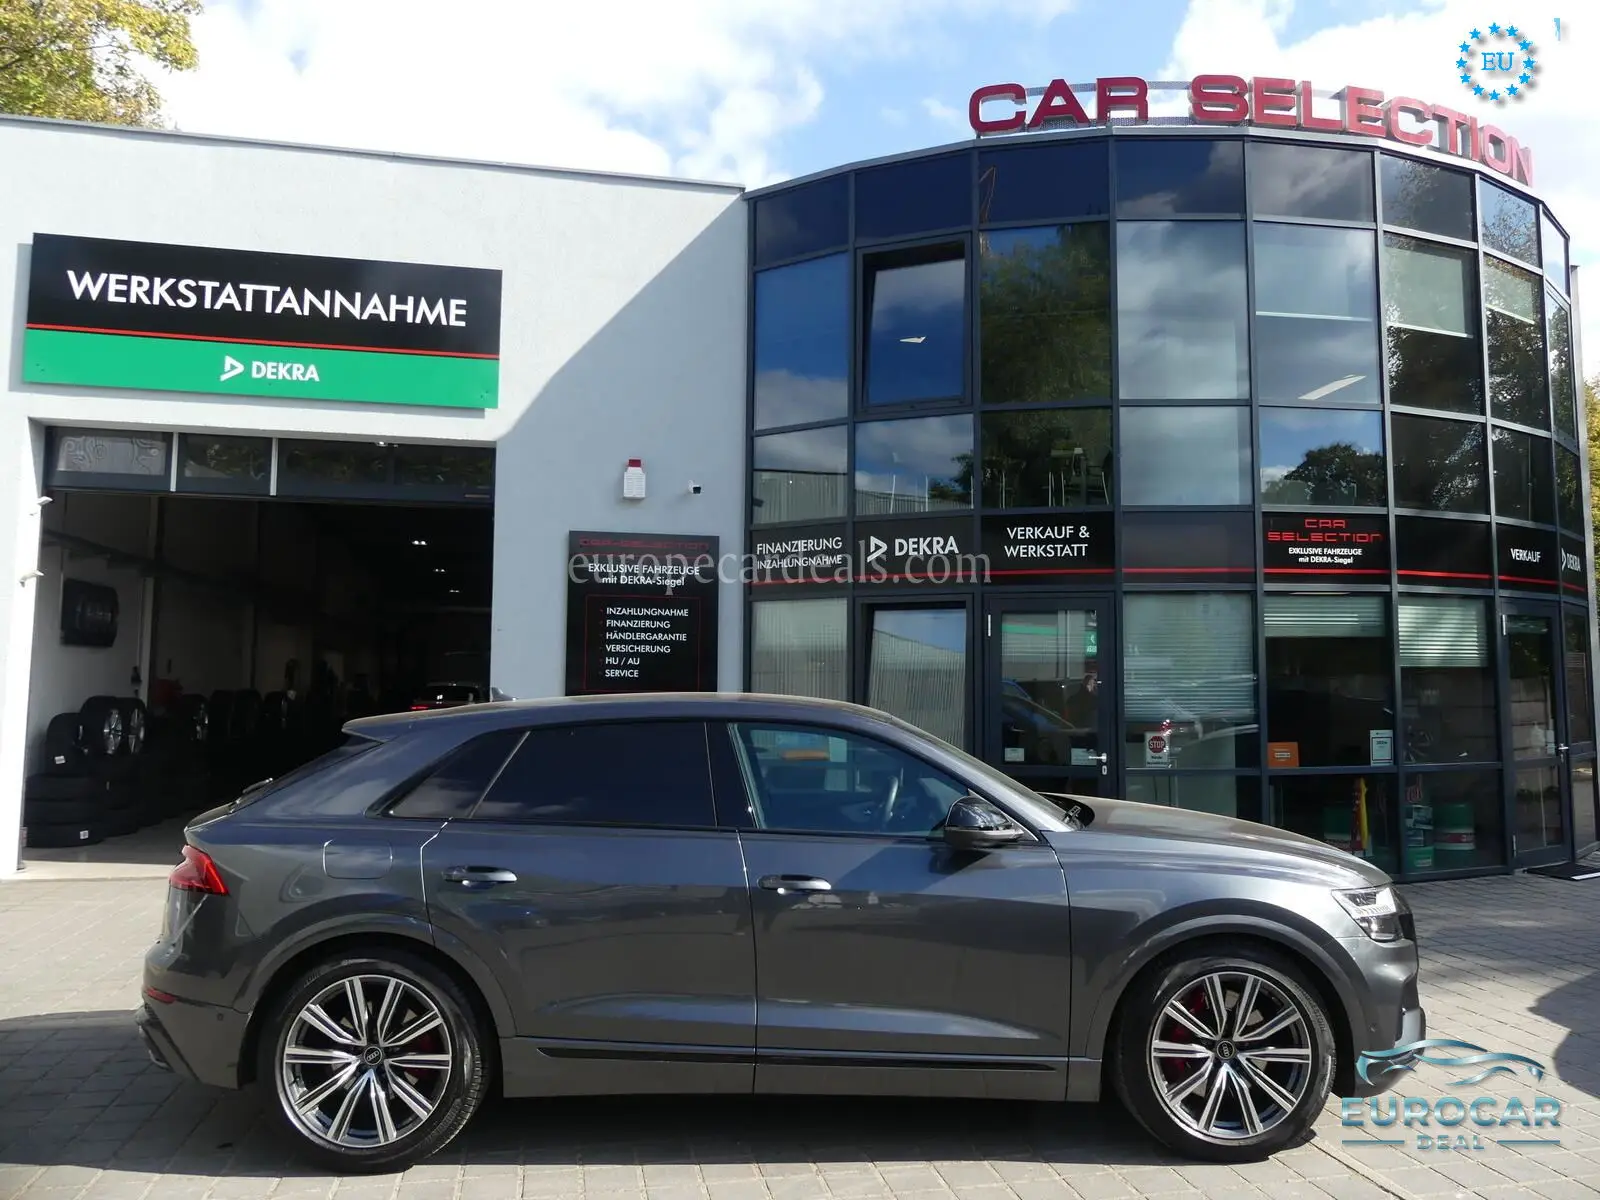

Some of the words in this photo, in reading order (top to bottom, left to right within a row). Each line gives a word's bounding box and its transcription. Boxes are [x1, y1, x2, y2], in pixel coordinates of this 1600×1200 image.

[969, 77, 1148, 132] CAR
[1190, 74, 1534, 187] SELECTION
[67, 270, 467, 326] WERKSTATTANNAHME
[252, 360, 320, 382] DEKRA
[1006, 526, 1075, 540] VERKAUF
[1079, 526, 1090, 538] &
[1267, 532, 1384, 542] SELECTION
[757, 537, 843, 555] FINANZIERUNG
[895, 536, 960, 556] DEKRA
[1004, 544, 1088, 558] WERKSTATT
[1288, 547, 1322, 555] EXKLUSIVE
[1324, 547, 1363, 556] FAHRZEUGE
[757, 554, 843, 570] INZAHLUNGNAHME
[1310, 556, 1354, 565] DEKRA-Siegel
[1510, 548, 1541, 563] VERKAUF
[588, 563, 640, 574] EXKLUSIVE
[642, 565, 700, 576] FAHRZEUGE
[602, 575, 617, 584] mit
[620, 576, 685, 588] DEKRA-Siegel
[606, 607, 689, 617] INZAHLUNGNAHME
[606, 620, 671, 629] FINANZIERUNG
[606, 631, 688, 641] HÄNDLERGARANTIE
[605, 644, 671, 653] VERSICHERUNG
[605, 657, 619, 665] HU
[621, 657, 626, 666] /
[627, 657, 640, 665] AU
[605, 669, 639, 678] SERVICE
[1150, 740, 1165, 749] STOP
